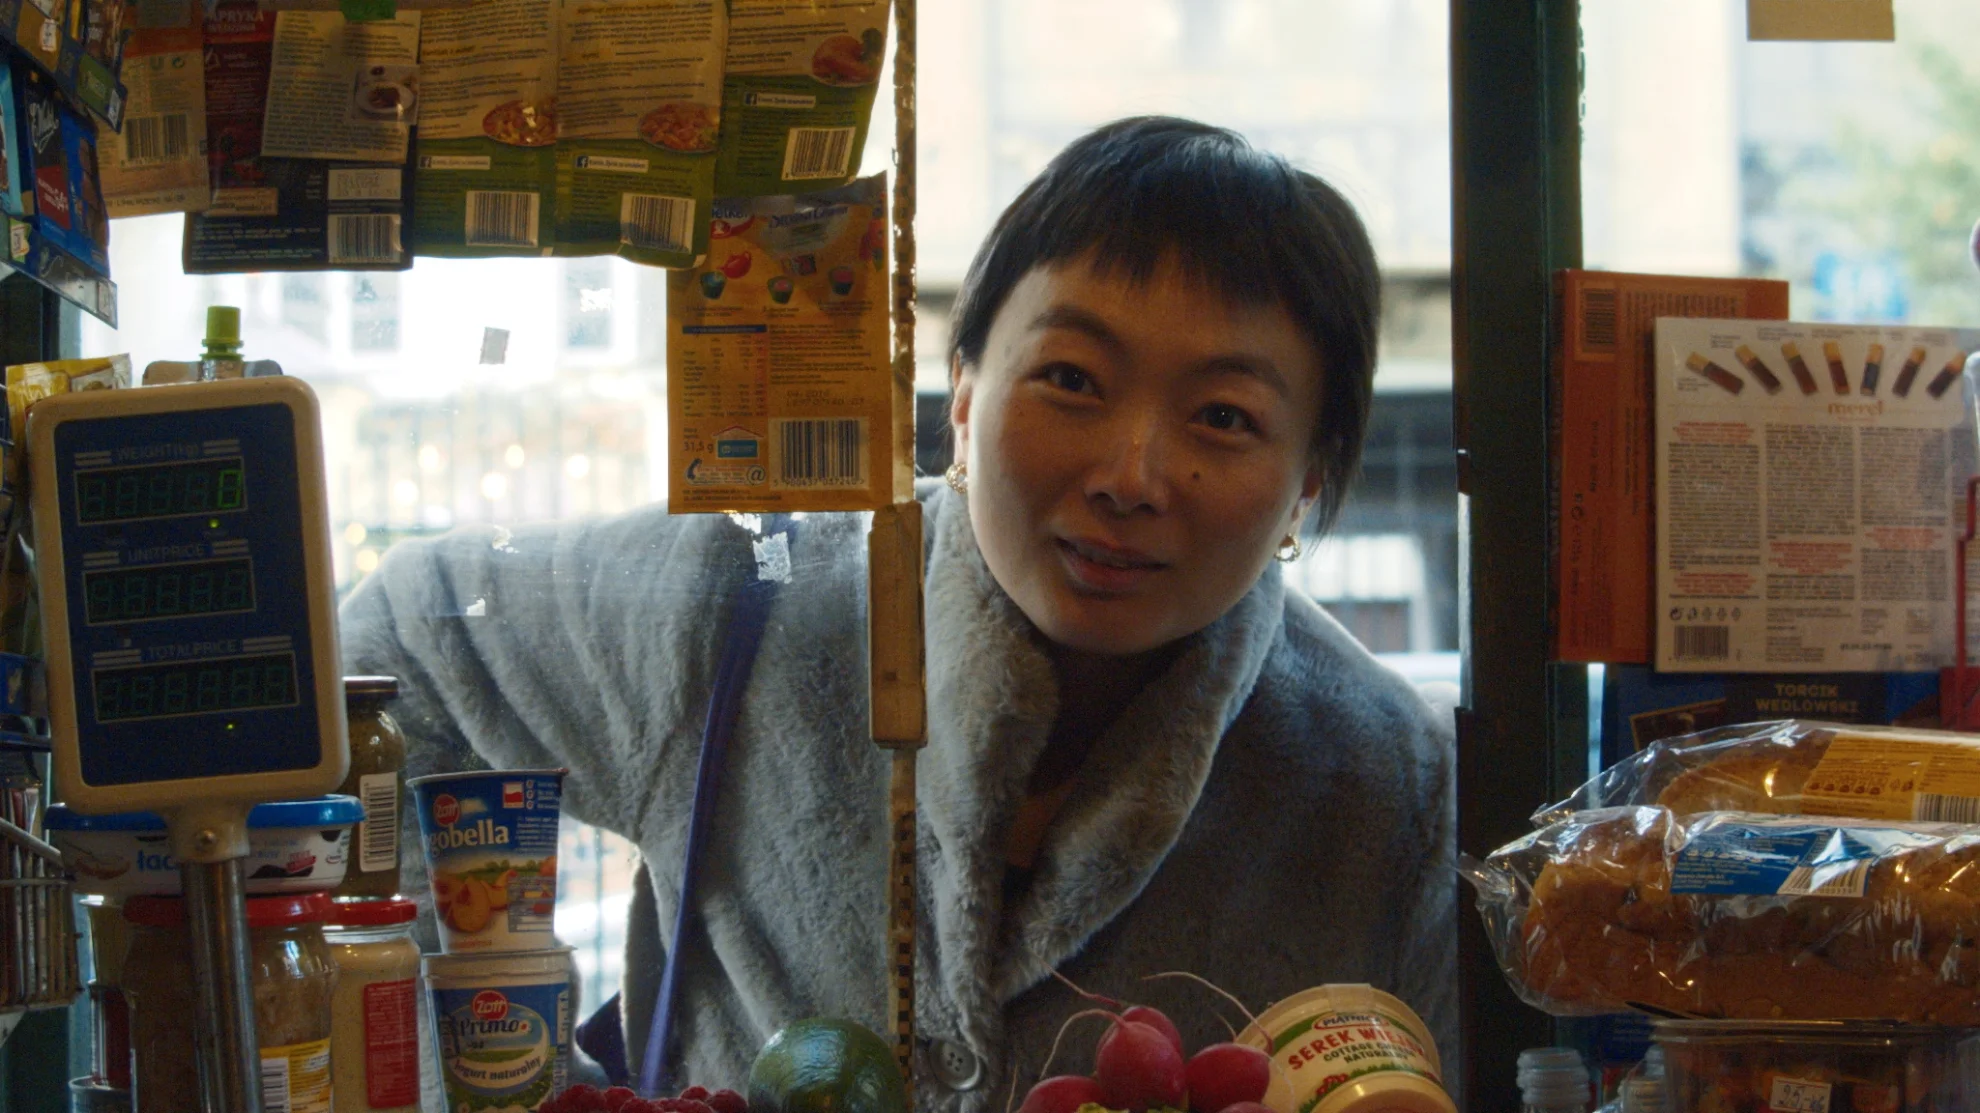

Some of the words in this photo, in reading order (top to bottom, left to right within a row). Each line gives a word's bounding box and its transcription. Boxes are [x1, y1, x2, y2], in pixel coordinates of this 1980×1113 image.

[204, 9, 264, 22] APRYKA
[218, 469, 242, 508] 0
[1776, 683, 1839, 697] TORCIK
[430, 819, 509, 858] gobella
[137, 849, 179, 871] łac
[475, 1000, 506, 1014] Zott
[460, 1018, 520, 1037] Primo
[1288, 1030, 1356, 1071] SEREK
[1323, 1042, 1373, 1062] COTTAGE
[490, 1056, 541, 1081] naturalny
